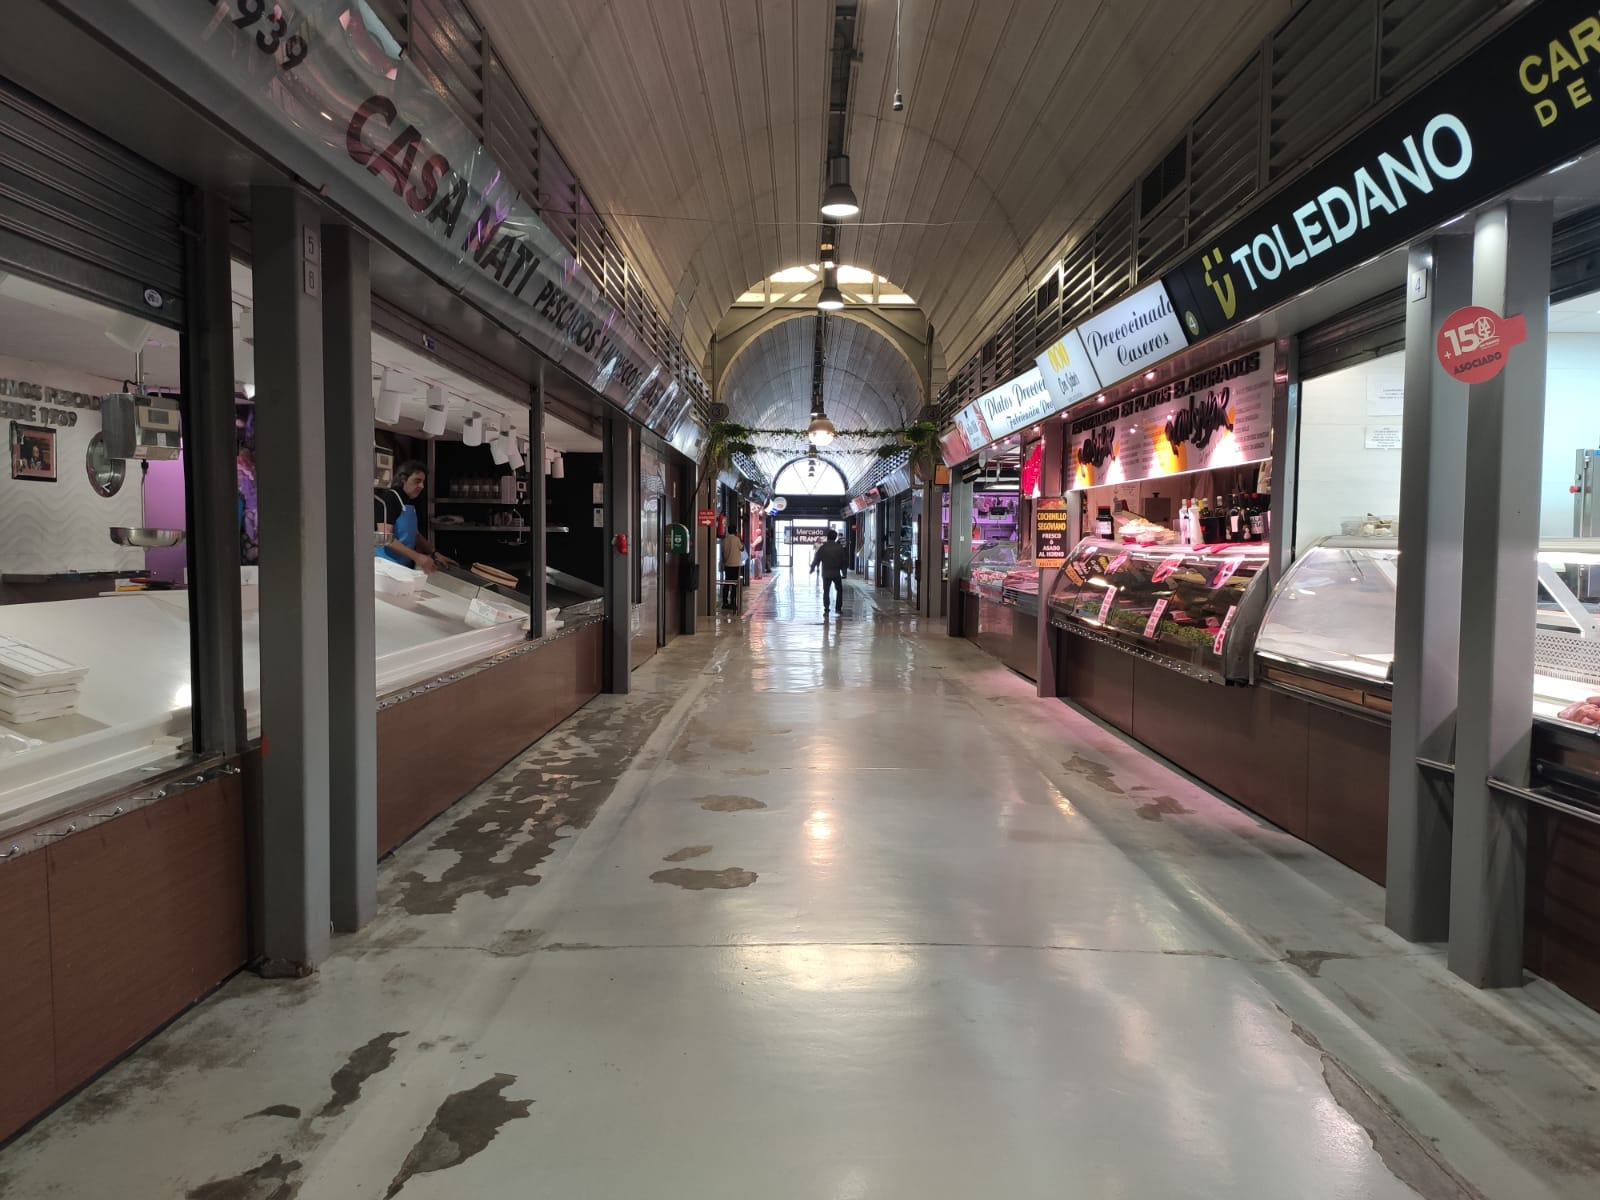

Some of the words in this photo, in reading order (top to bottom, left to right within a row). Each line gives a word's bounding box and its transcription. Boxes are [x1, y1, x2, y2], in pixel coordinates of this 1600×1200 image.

[209, 0, 308, 71] 939
[1533, 77, 1593, 128] DE
[1231, 113, 1473, 291] TOLEDANO
[346, 95, 468, 238] CASA
[532, 279, 601, 353] PESCADOS
[1117, 331, 1169, 366] Caseros
[1454, 351, 1502, 374] ASOCIADO
[1135, 385, 1171, 412] PLATOS
[1174, 351, 1260, 399] ELABORADOS
[984, 395, 1013, 421] Platos
[1037, 512, 1067, 520] COCHINILLO
[1037, 522, 1067, 530] SEGOVIANO
